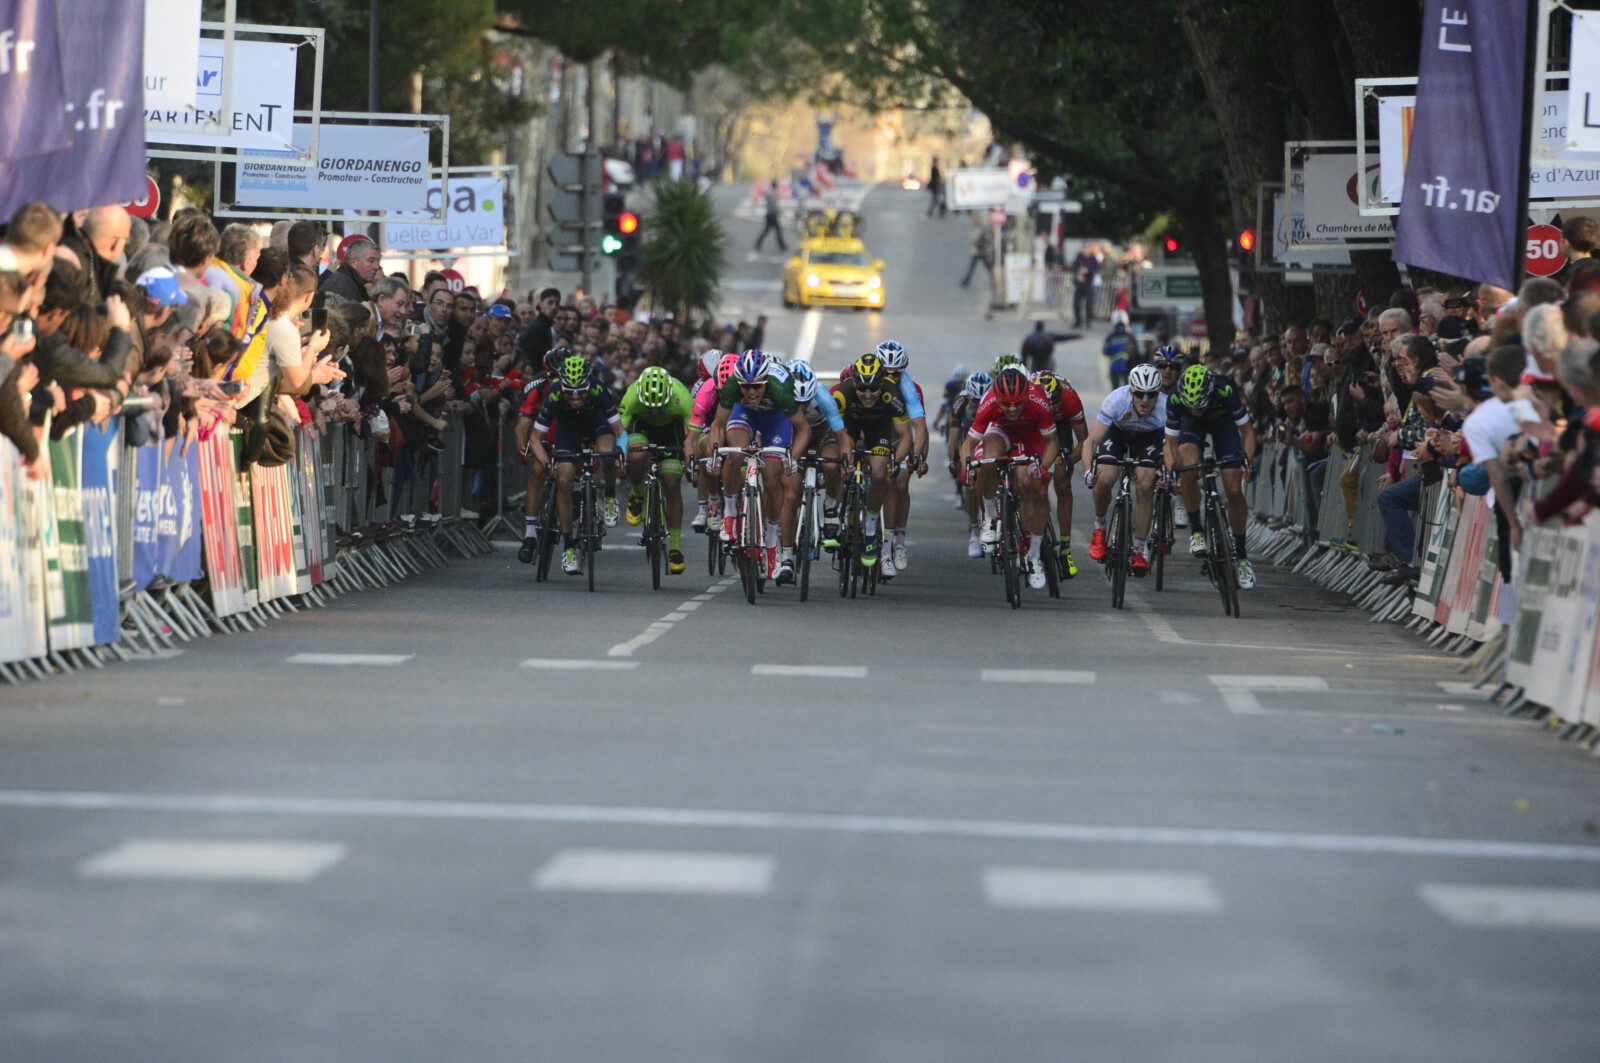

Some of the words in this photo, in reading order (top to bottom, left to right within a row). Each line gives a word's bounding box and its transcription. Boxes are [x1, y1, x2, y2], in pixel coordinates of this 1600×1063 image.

[65, 88, 124, 130] .fr
[320, 157, 422, 173] GIORDANENGO
[318, 171, 362, 183] Promoteur
[371, 174, 423, 185] Constructeur
[437, 226, 462, 242] du
[466, 224, 497, 241] Var
[1316, 223, 1362, 233] Chambres
[1364, 222, 1376, 232] de
[1526, 239, 1559, 260] 50
